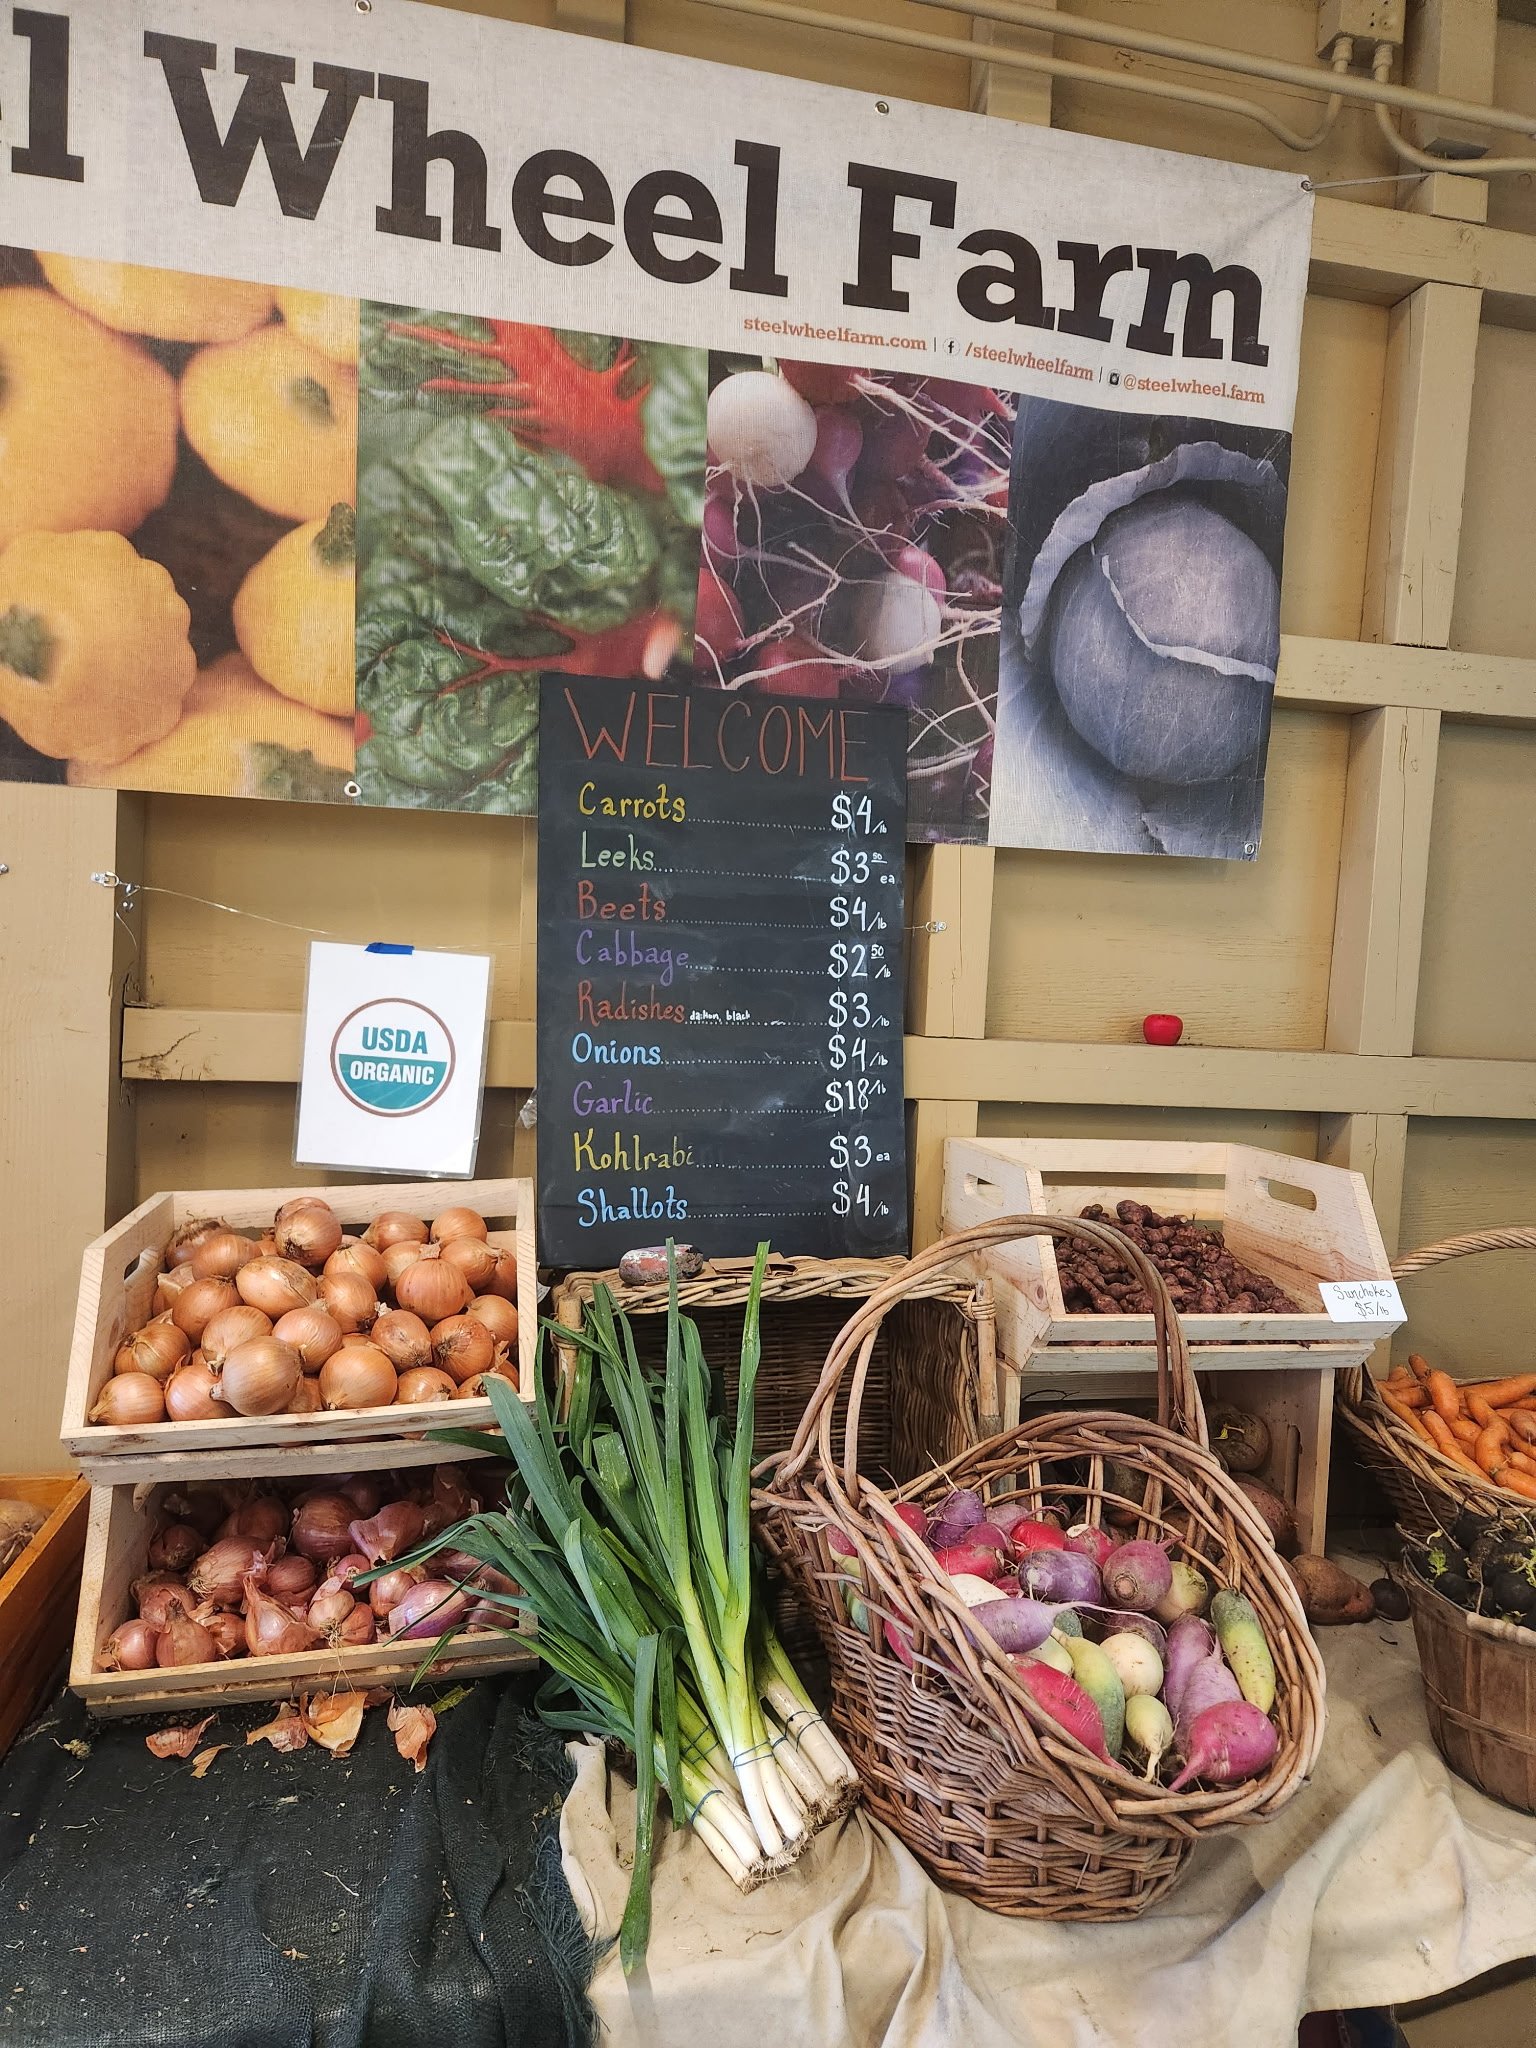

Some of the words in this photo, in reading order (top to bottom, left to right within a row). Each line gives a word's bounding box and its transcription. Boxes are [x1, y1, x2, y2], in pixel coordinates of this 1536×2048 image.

[144, 30, 788, 297] Wheel
[843, 161, 1268, 367] Farm
[744, 317, 927, 351] steelwheelfarm.com
[965, 342, 1094, 381] /steelwheelfarm
[1123, 374, 1266, 404] @steelwheel.farm
[564, 688, 869, 783] WELCOME
[578, 781, 687, 823] Carrots
[581, 830, 655, 871] Leeks
[577, 879, 667, 921] Beets
[576, 929, 689, 987] Cabbage
[578, 979, 686, 1026] Radishes
[726, 1010, 751, 1022] black
[361, 1026, 428, 1055] USDA
[572, 1032, 662, 1066] Onions
[350, 1060, 435, 1086] ORGANIC
[573, 1080, 654, 1117] Garlic
[573, 1127, 695, 1172] Kohlrabi
[578, 1185, 689, 1228] Shallots
[1333, 1283, 1393, 1301] Sunchokes
[1354, 1301, 1389, 1319] $5/lb
